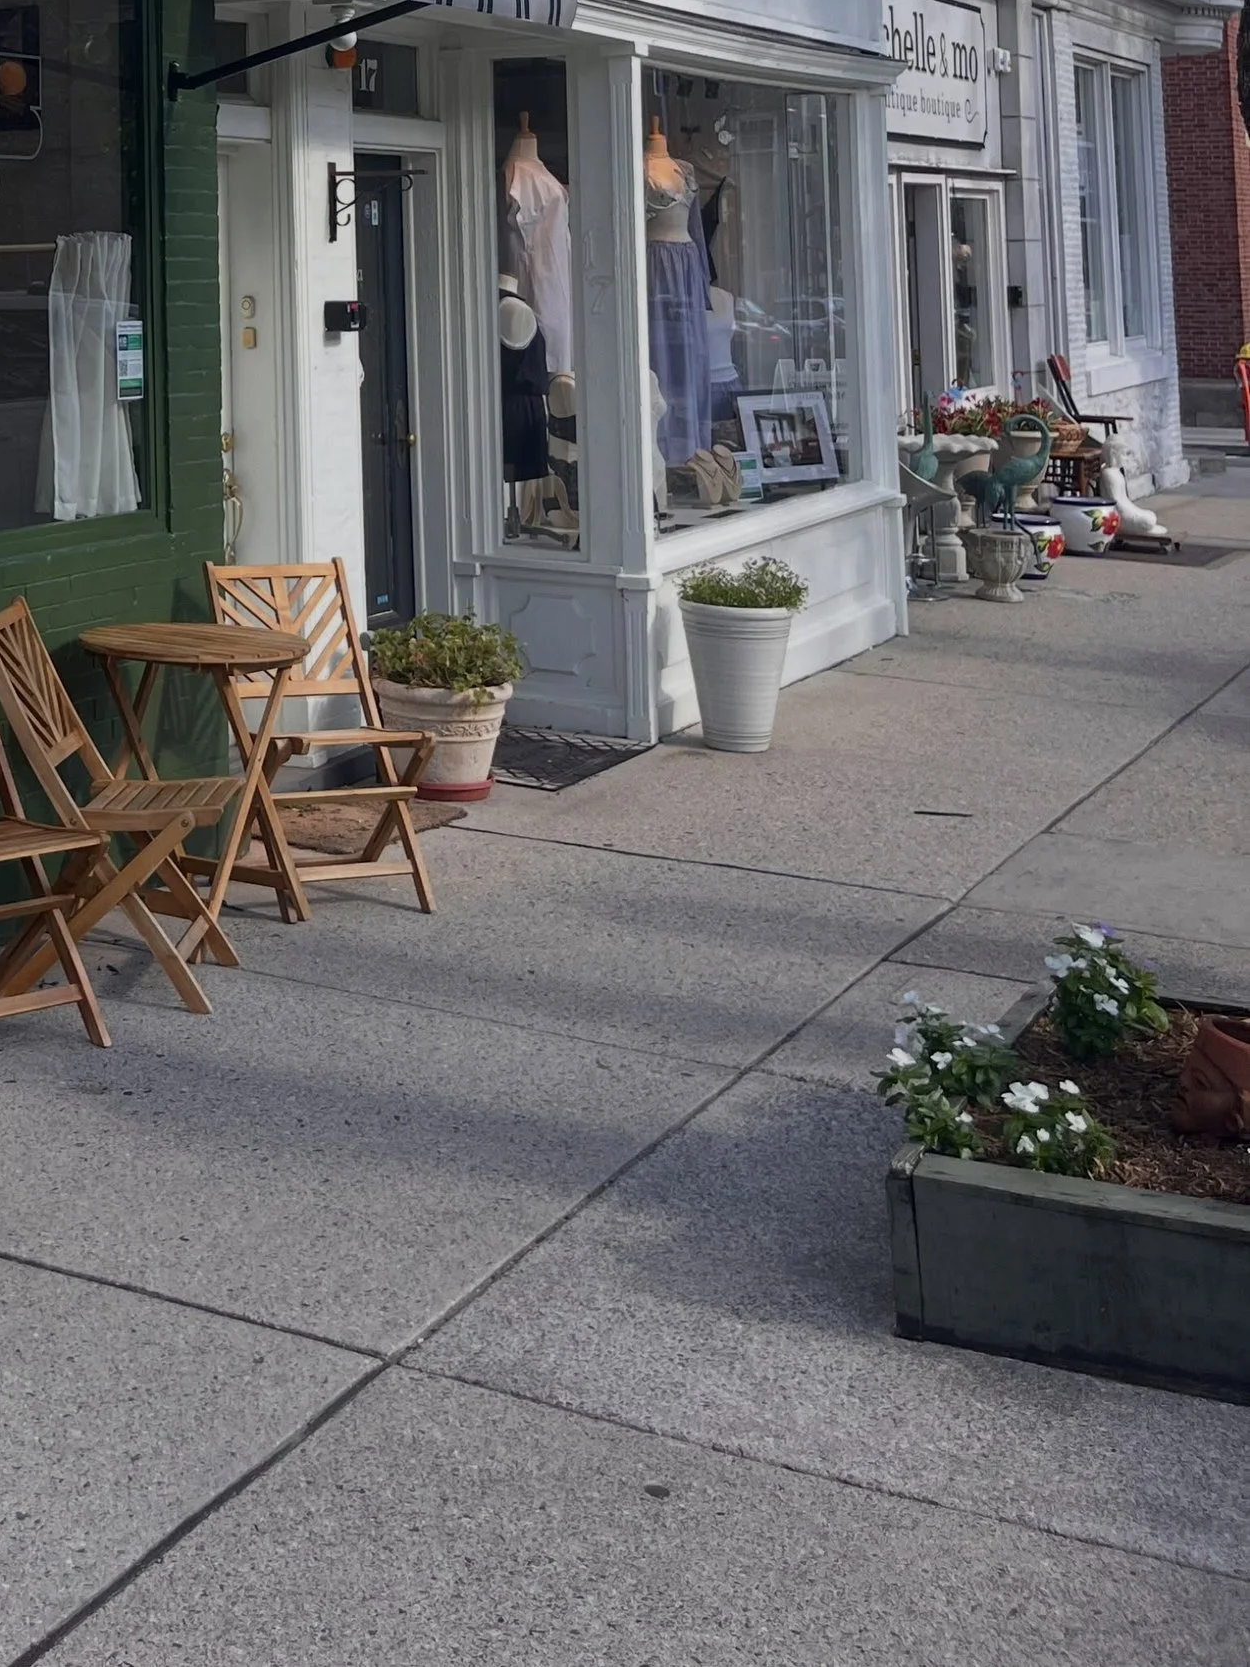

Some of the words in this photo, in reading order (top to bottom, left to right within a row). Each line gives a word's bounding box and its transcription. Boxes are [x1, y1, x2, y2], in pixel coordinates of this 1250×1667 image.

[883, 5, 937, 75] helle
[951, 40, 979, 84] mo
[359, 58, 378, 92] 17
[920, 87, 961, 124] boutique
